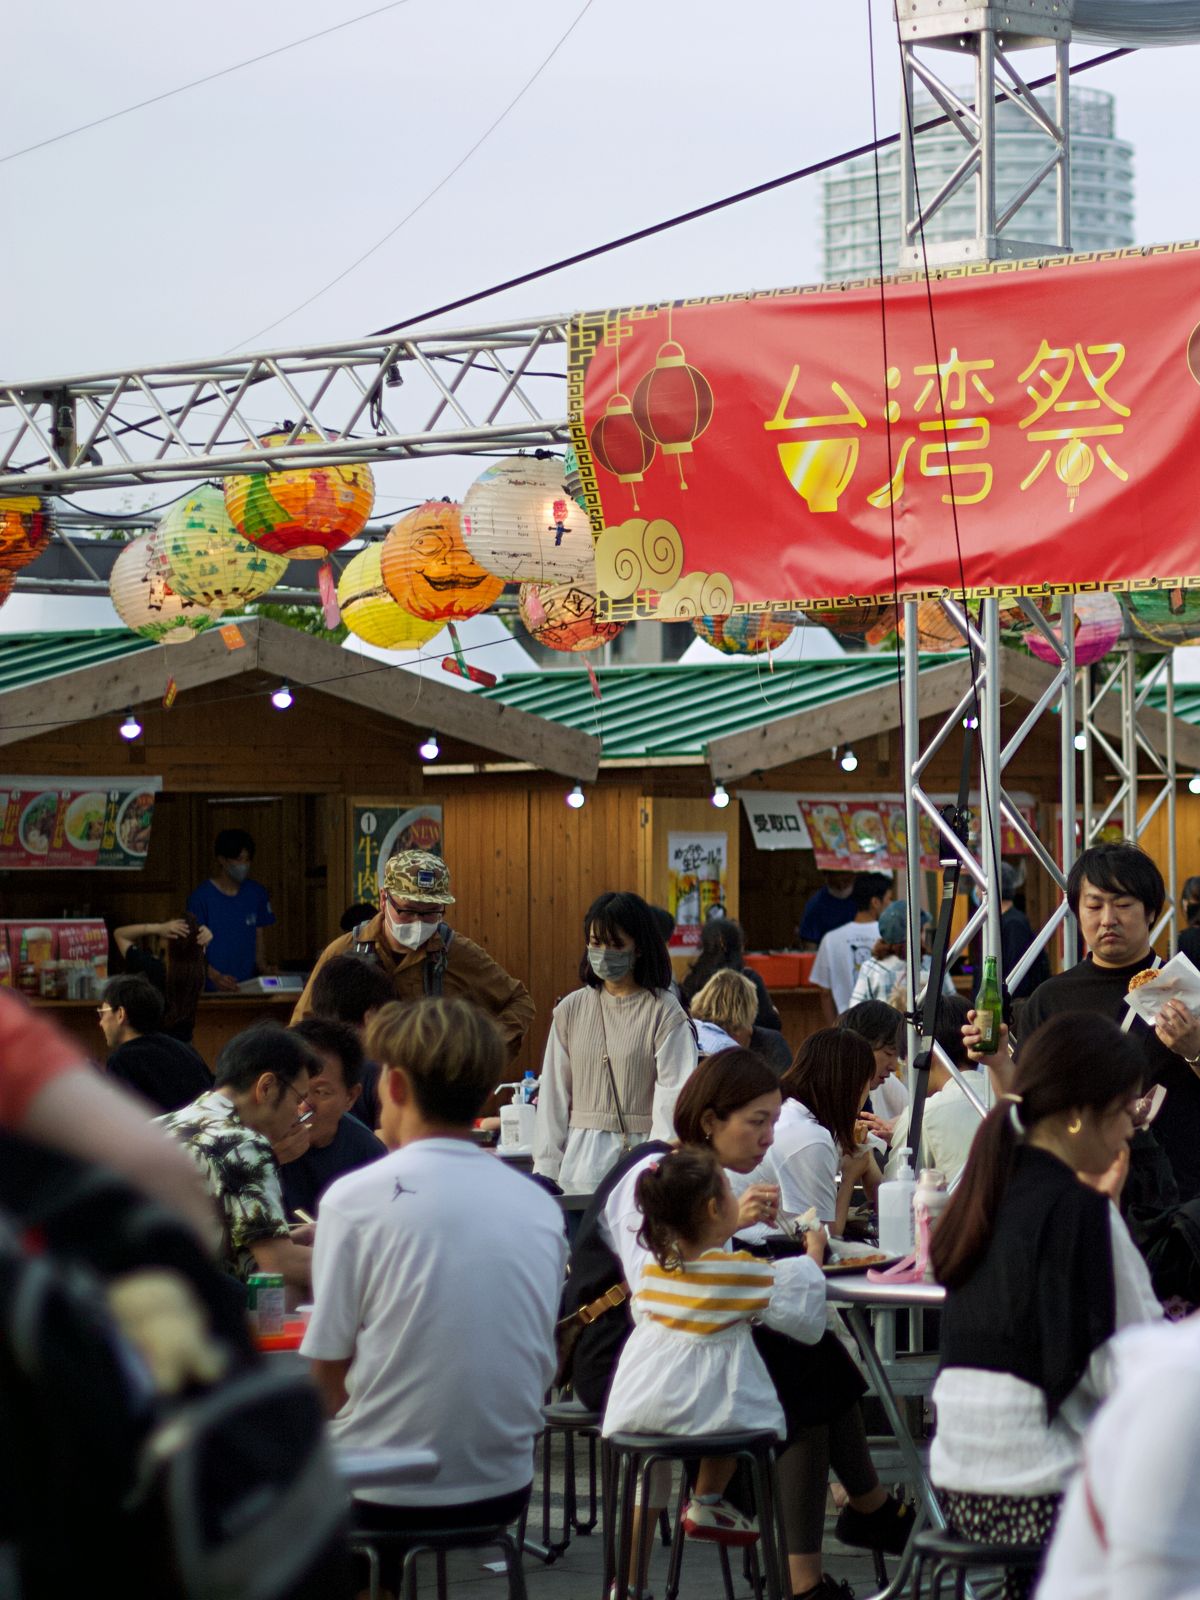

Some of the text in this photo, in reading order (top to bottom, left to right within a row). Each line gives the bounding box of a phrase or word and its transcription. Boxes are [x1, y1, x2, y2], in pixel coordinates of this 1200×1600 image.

[764, 339, 1132, 512] 台湾祭
[410, 824, 441, 839] NEW
[753, 814, 801, 833] 受取口
[358, 835, 379, 908] 牛肉
